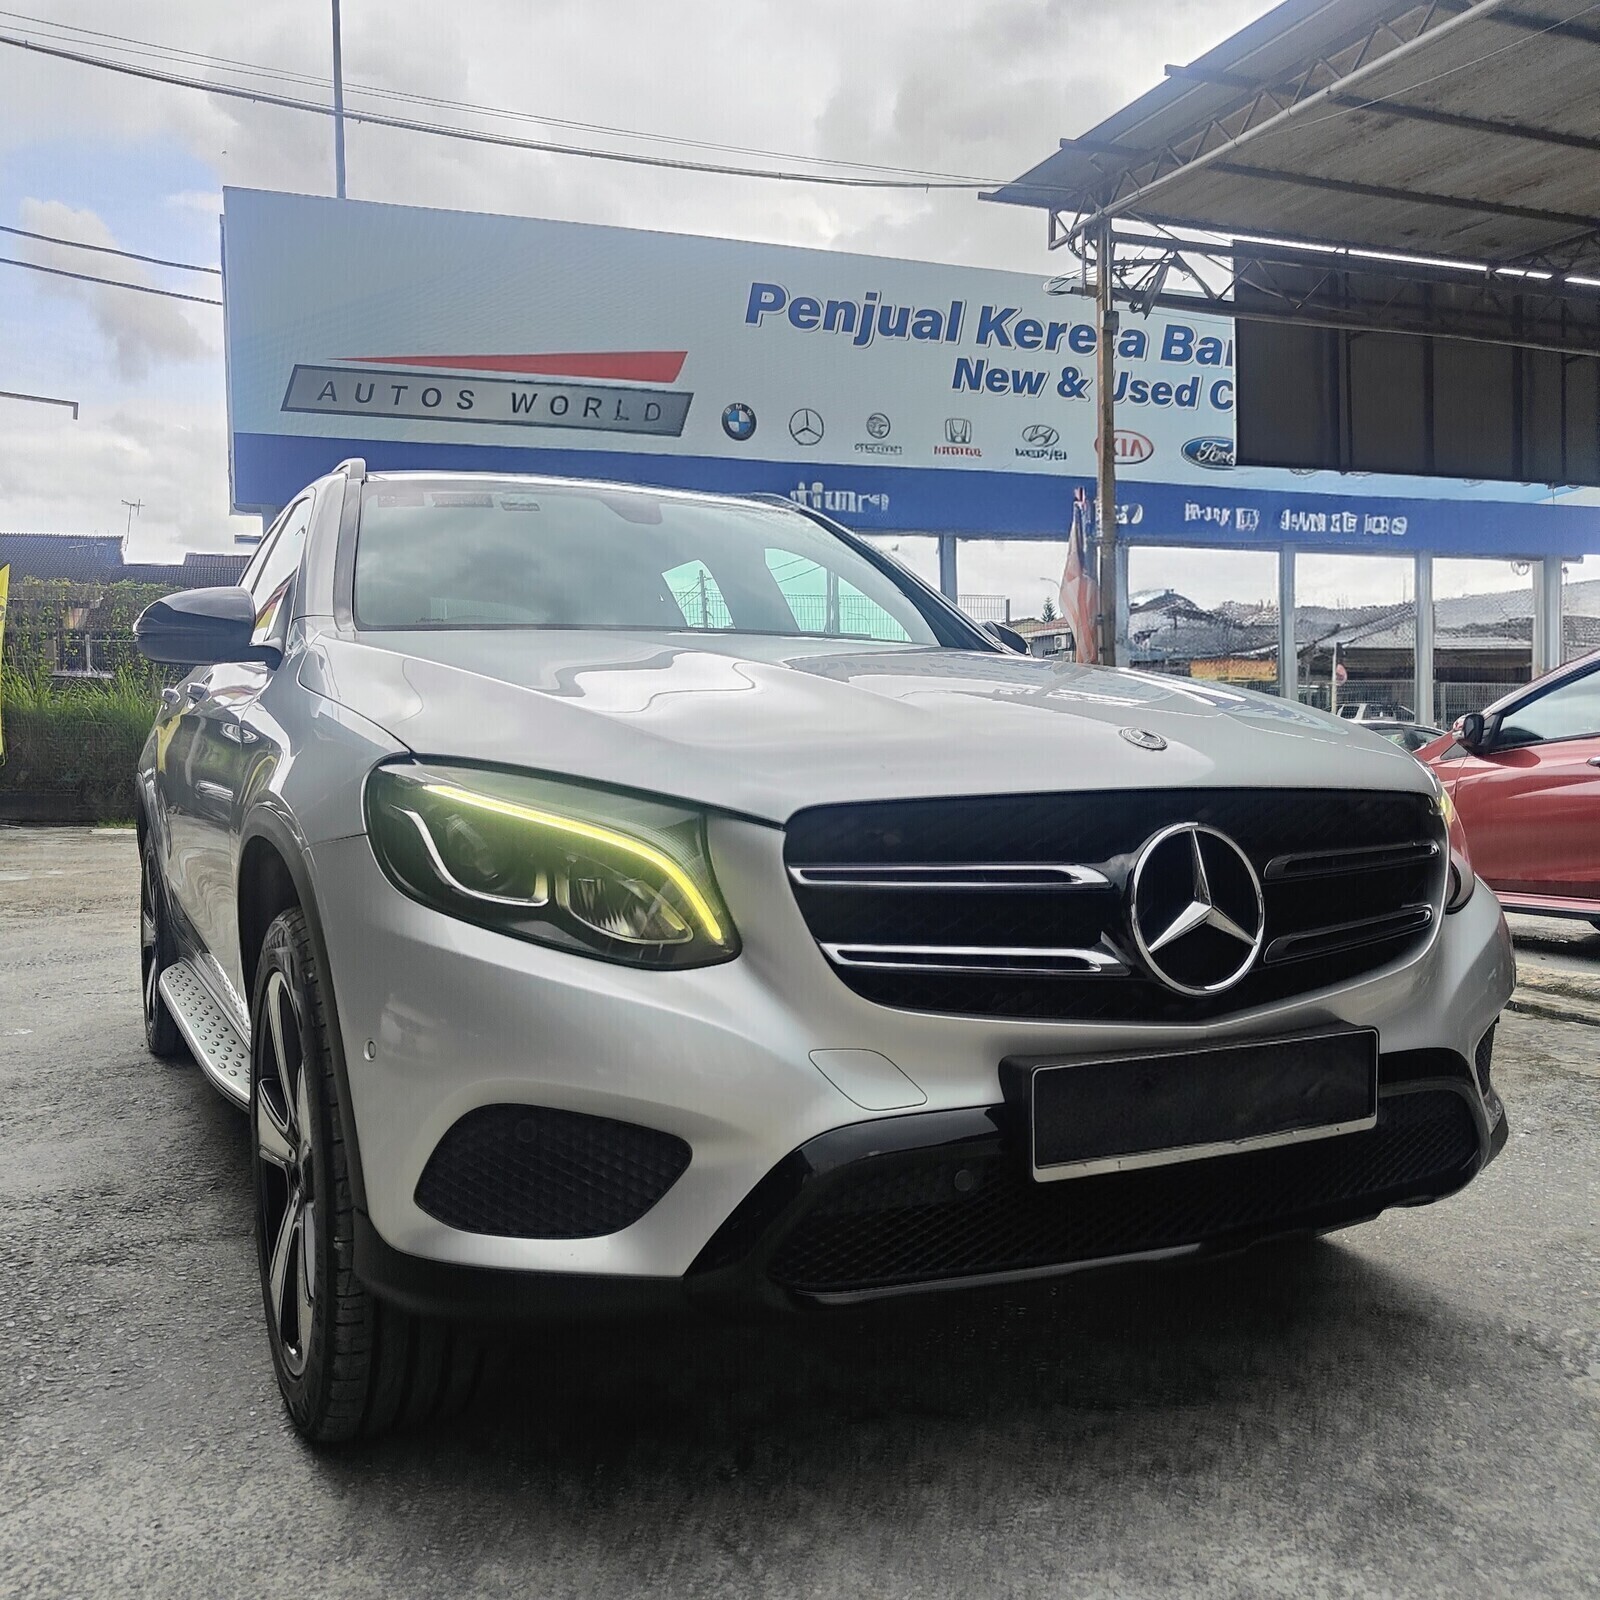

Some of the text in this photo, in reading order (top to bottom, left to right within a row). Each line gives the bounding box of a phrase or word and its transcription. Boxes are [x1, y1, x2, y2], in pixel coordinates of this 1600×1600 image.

[745, 281, 966, 348] Penjual
[975, 305, 1147, 360] Kerea
[952, 357, 1048, 396] New
[1056, 366, 1091, 400] &
[317, 380, 662, 422] AUTOS WORLD
